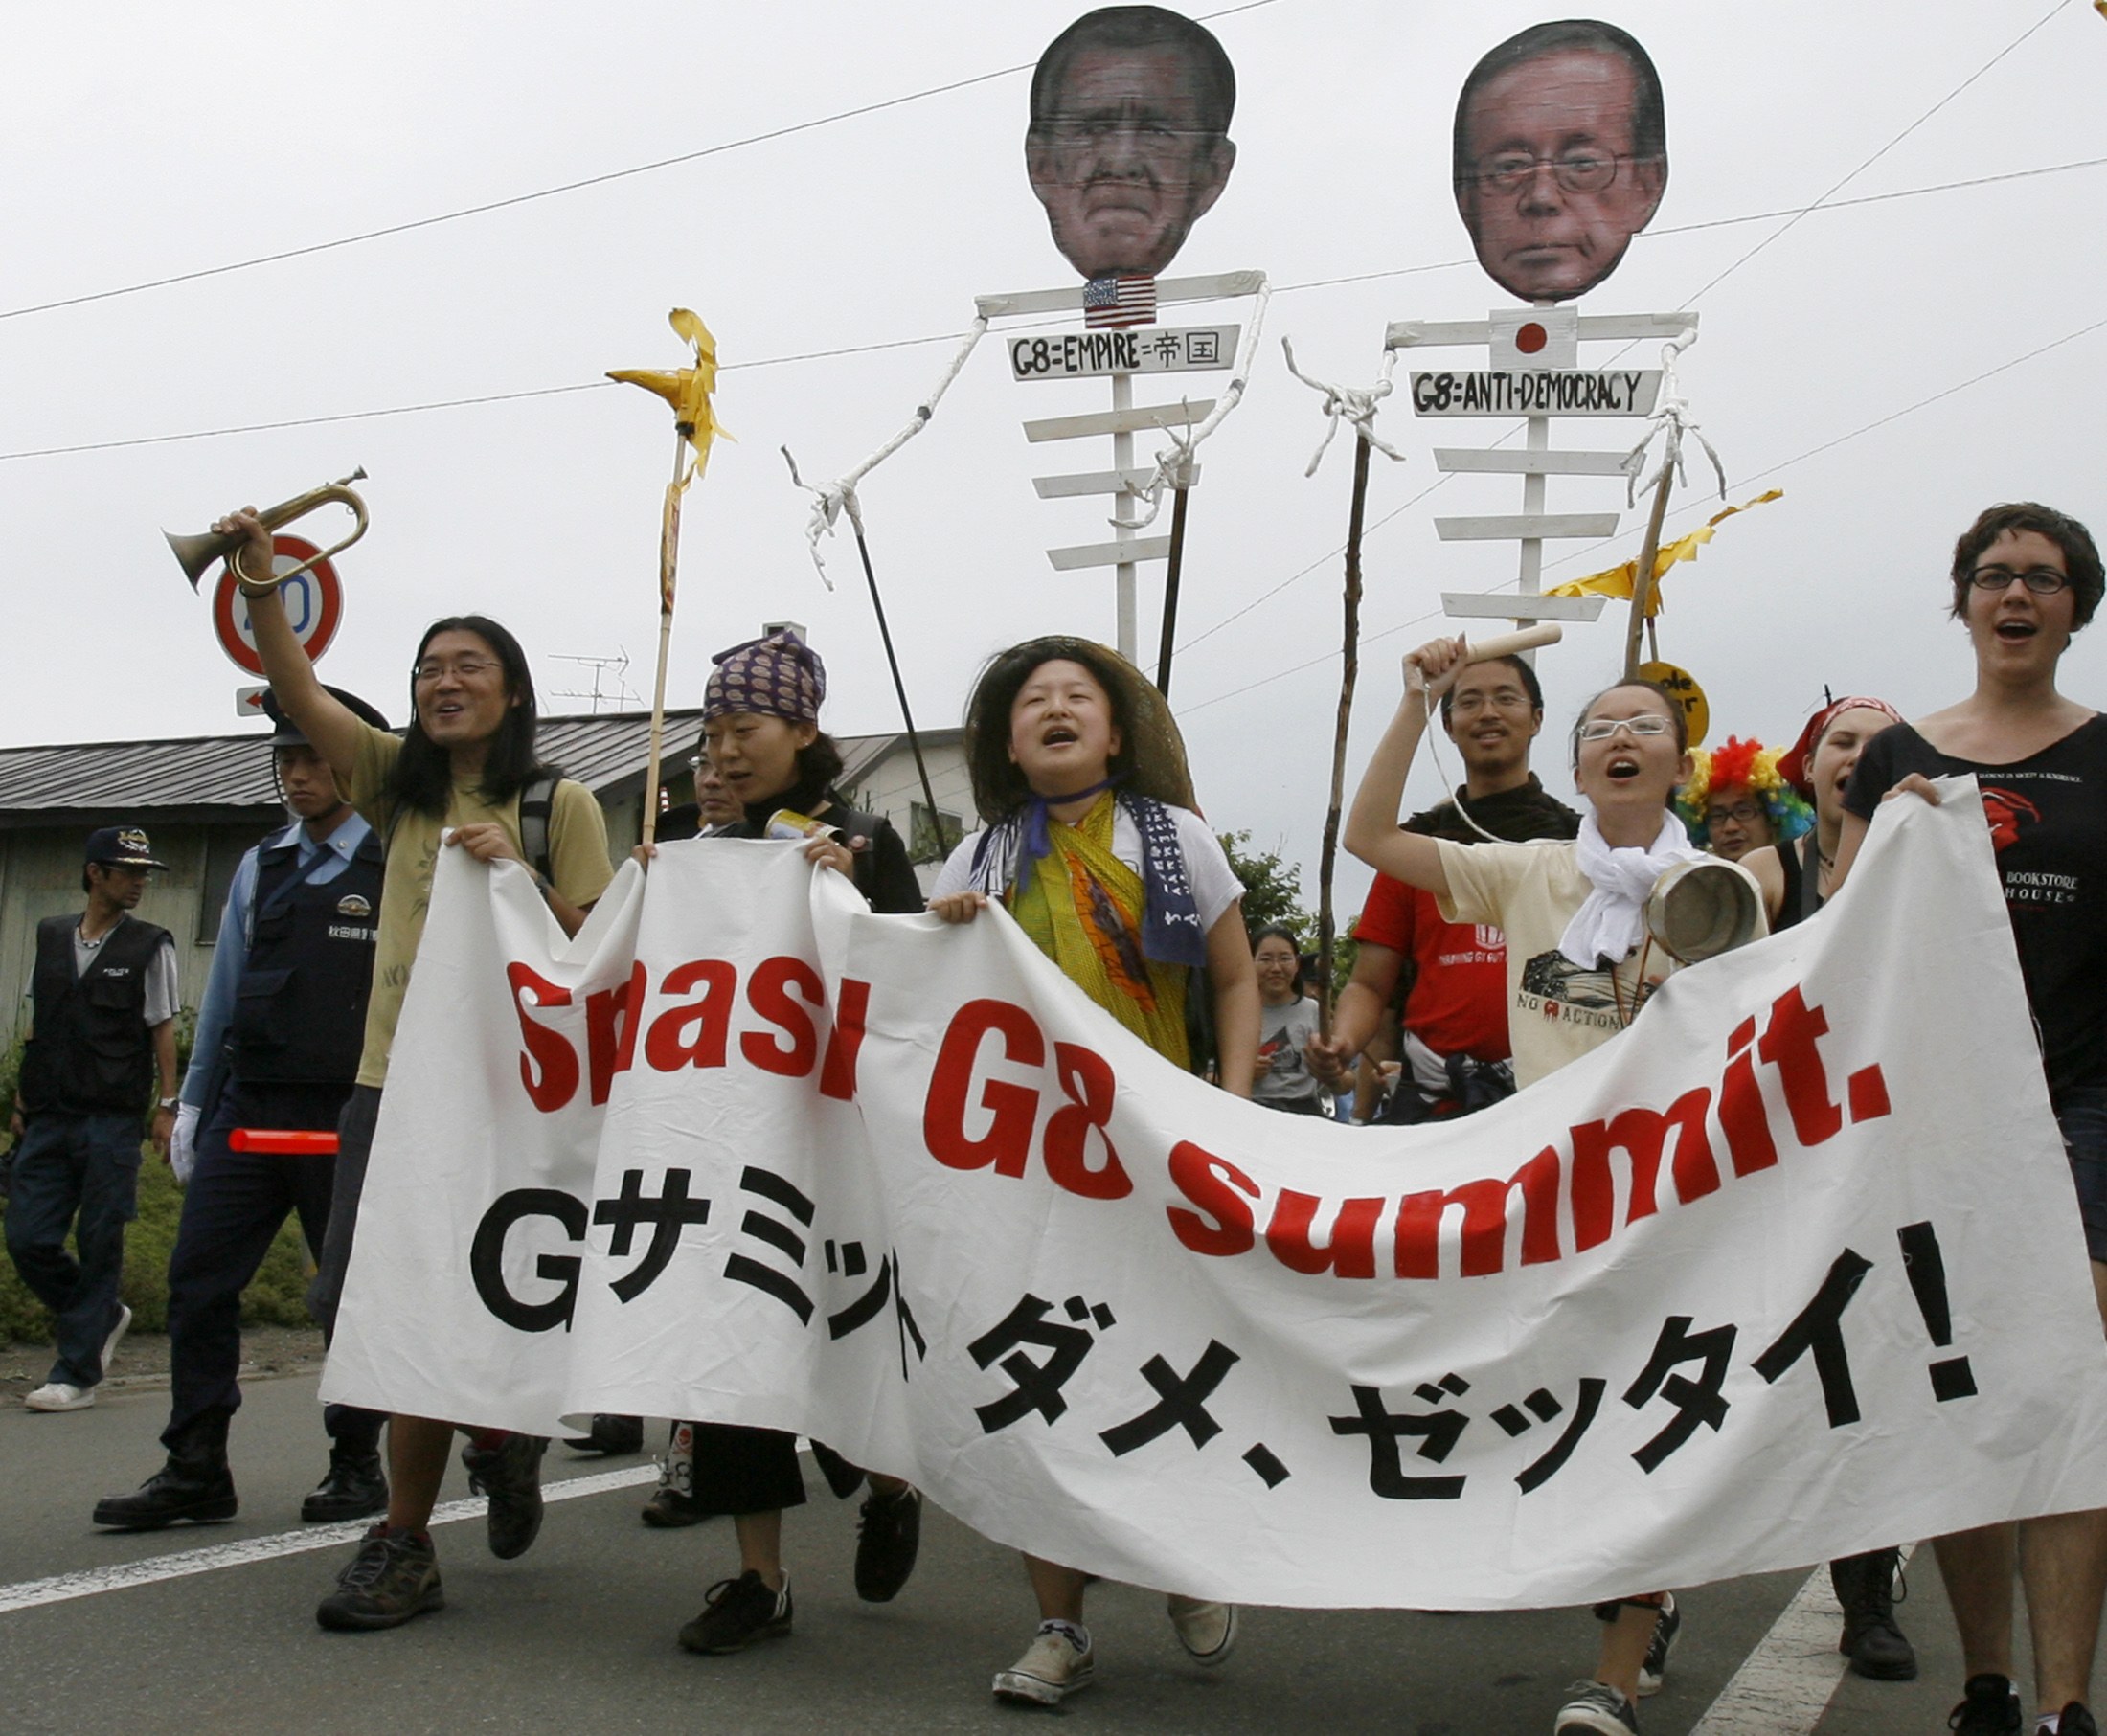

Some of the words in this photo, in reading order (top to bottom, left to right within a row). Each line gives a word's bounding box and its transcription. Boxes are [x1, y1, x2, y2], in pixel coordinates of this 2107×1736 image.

[1413, 372, 1643, 412] G8=ANTI-DEMOCRACY
[244, 574, 309, 633] 0
[2005, 870, 2079, 890] BOOKSTORE
[1516, 993, 1539, 1011] NO
[923, 999, 1134, 1201] G8
[1165, 984, 1892, 1281] summit.
